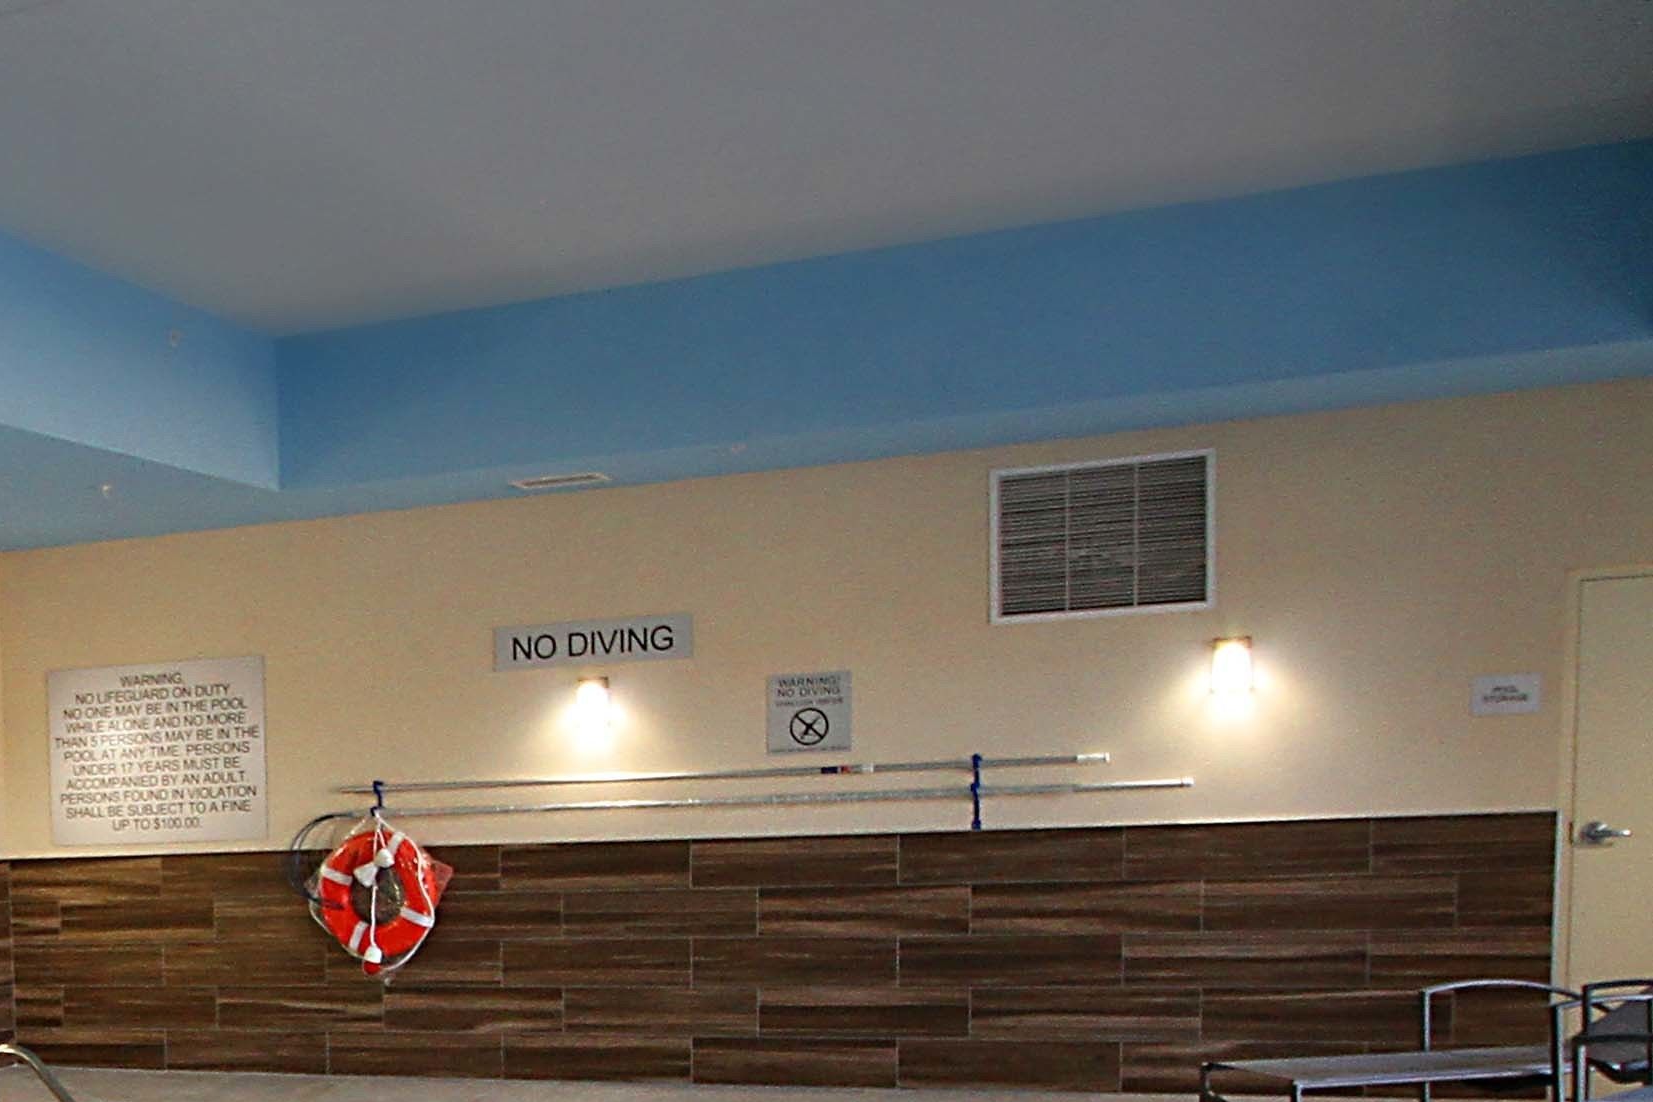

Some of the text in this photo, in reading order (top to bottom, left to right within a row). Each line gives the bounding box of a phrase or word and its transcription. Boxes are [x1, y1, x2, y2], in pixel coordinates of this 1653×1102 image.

[512, 625, 674, 661] NO DIVING
[119, 672, 183, 688] WARNING
[75, 683, 230, 704] NO LIFEGUARD ON DUTY
[777, 688, 795, 698] NO
[62, 696, 248, 719] NO ONE MAY BE IN THE POOL
[66, 711, 246, 734] WHILE ALONE AND NO MORE
[54, 736, 88, 749] THAN
[101, 731, 162, 747] PERSONS
[164, 729, 193, 742] MAY
[195, 728, 213, 741] BE
[216, 727, 230, 739] IN
[234, 724, 260, 739] THE
[63, 750, 97, 763] POOL
[101, 748, 117, 760] AT
[121, 746, 146, 760] ANY
[186, 740, 251, 757] PERSONS
[72, 762, 117, 777] UNDER
[137, 759, 181, 774] YEARS
[183, 757, 221, 770] MUST
[223, 756, 241, 769] BE
[66, 774, 159, 790] ACCOMPANIED
[161, 774, 178, 787] BY
[182, 773, 200, 785] AN
[60, 784, 258, 806] PERSONS FOUND IN VIOLATION
[66, 798, 253, 820] SHALL BE SUBJECT TO A FINE
[112, 819, 131, 832] UP
[133, 818, 151, 831] TO
